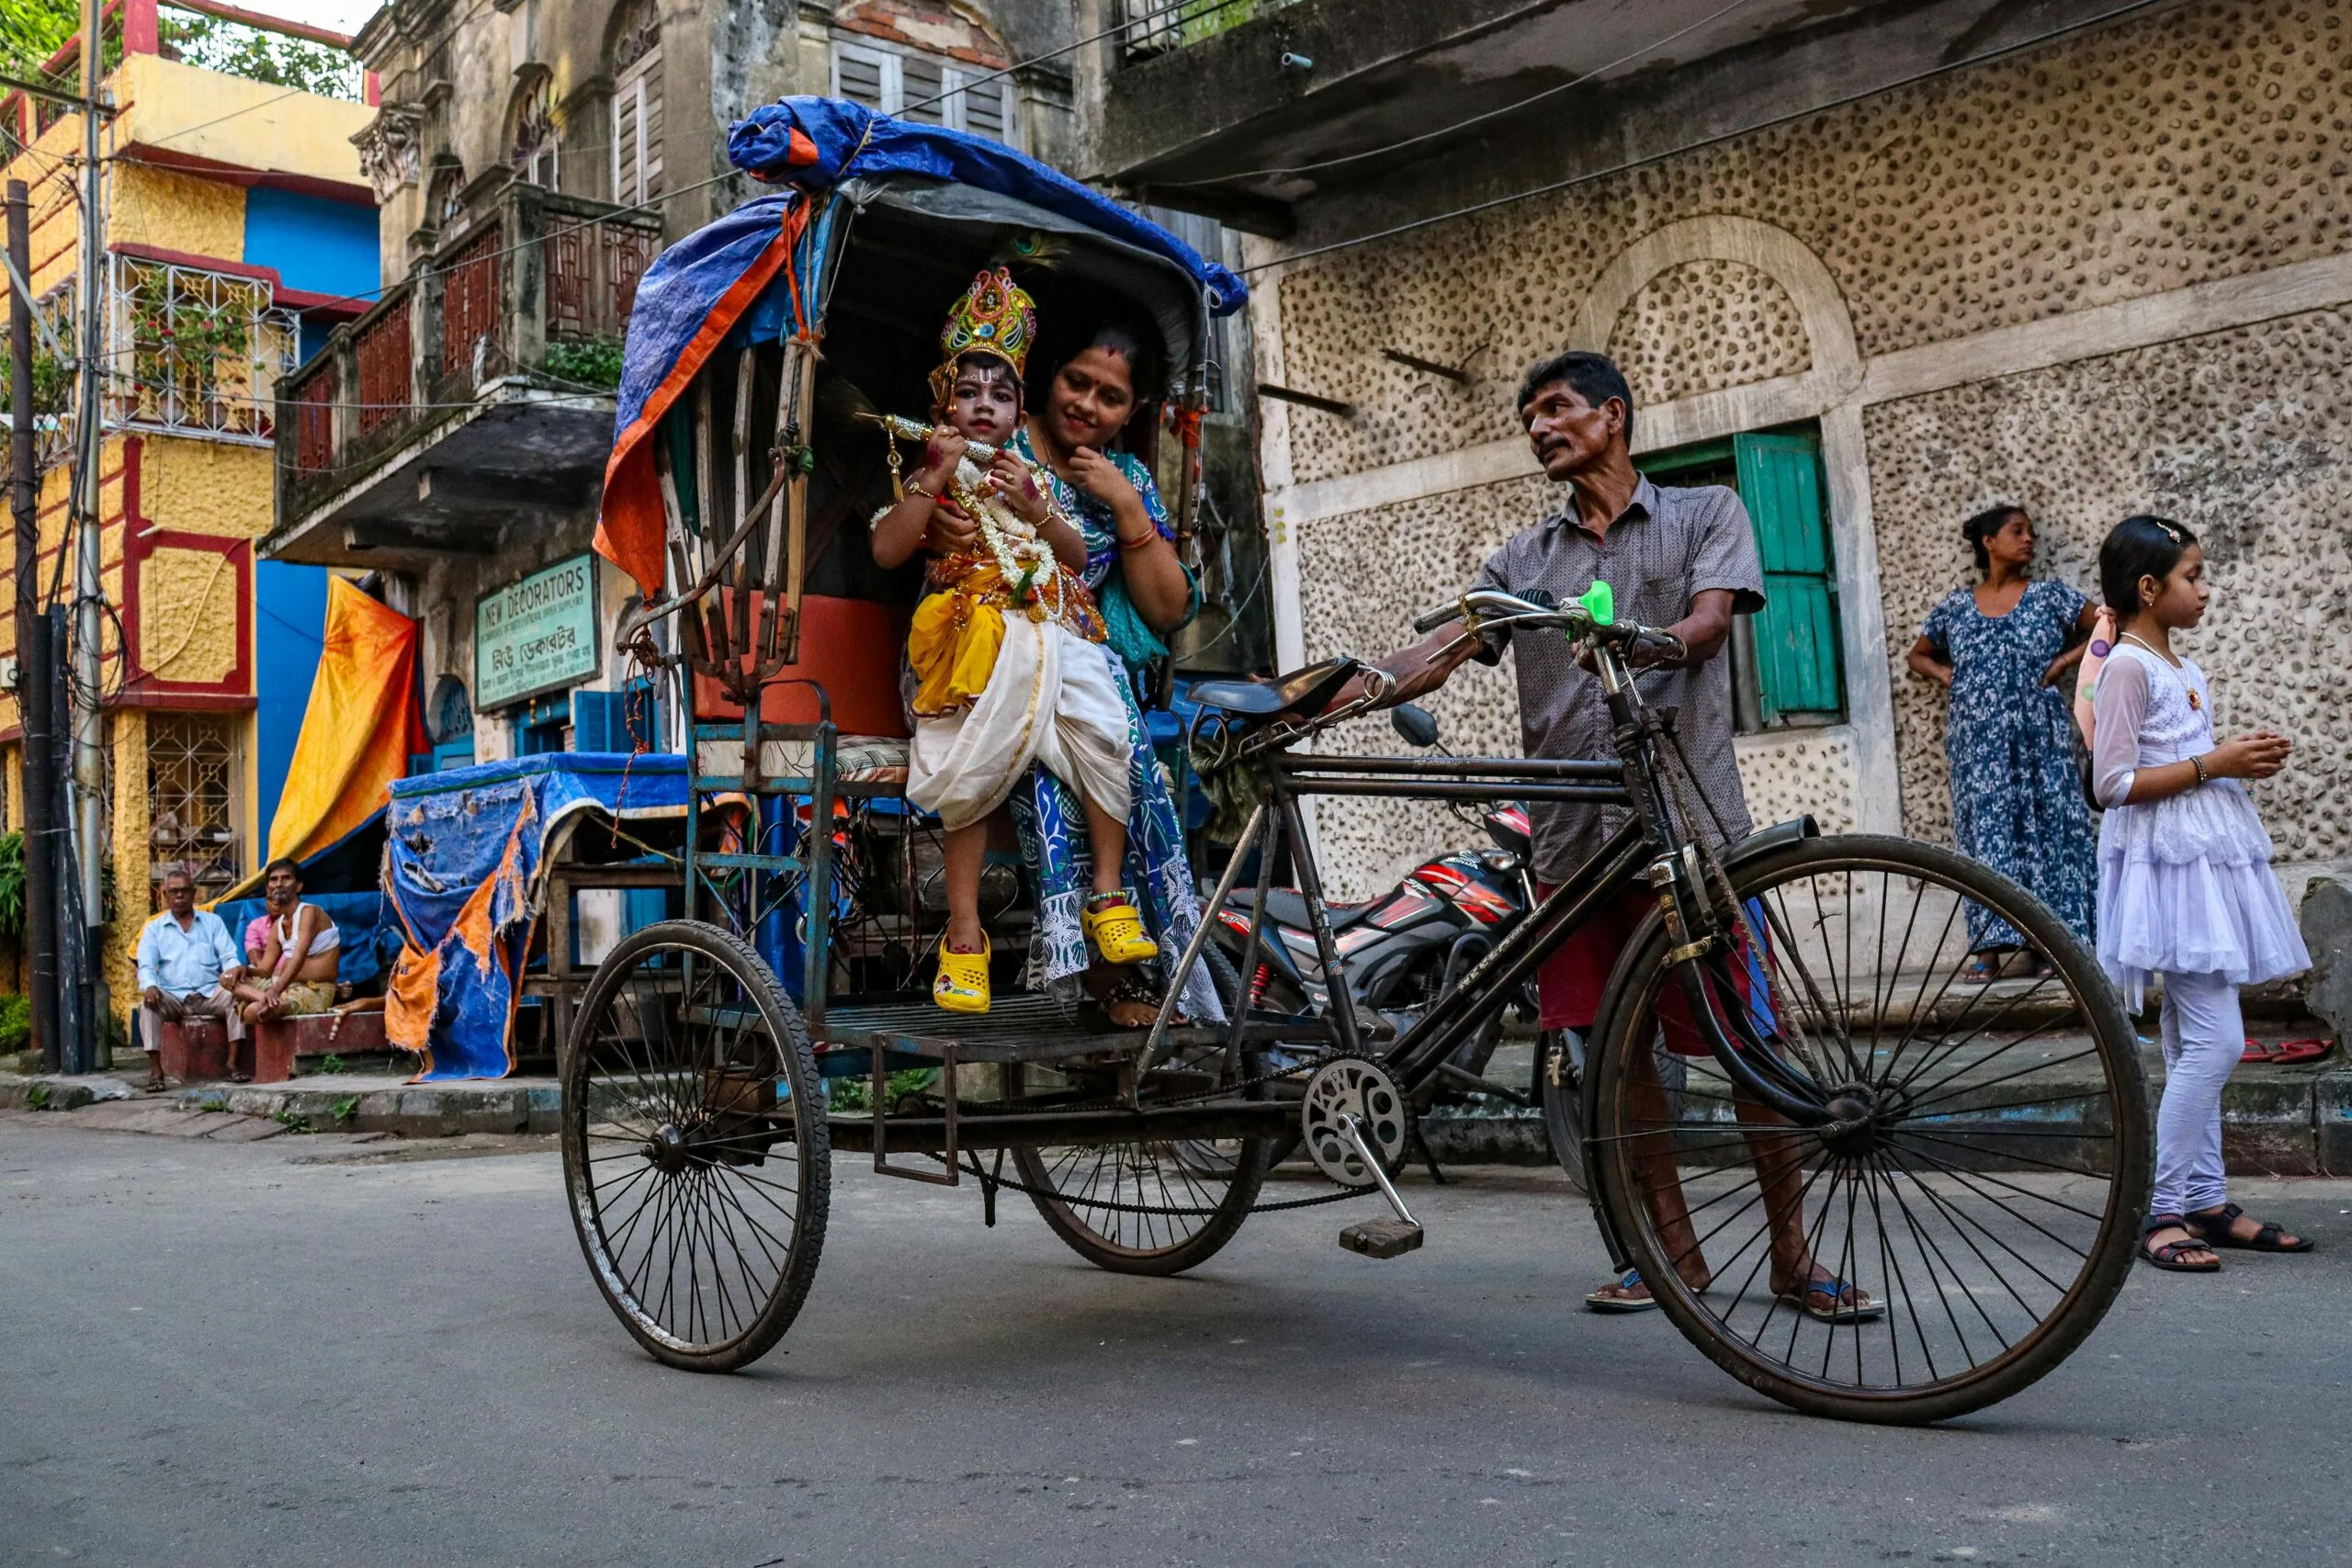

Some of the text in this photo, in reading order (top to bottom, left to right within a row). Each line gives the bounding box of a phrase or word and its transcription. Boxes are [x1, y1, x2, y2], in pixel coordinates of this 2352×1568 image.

[485, 600, 502, 628] NEW
[507, 566, 584, 618] DECORATORS
[1446, 856, 1479, 870] HONDA
